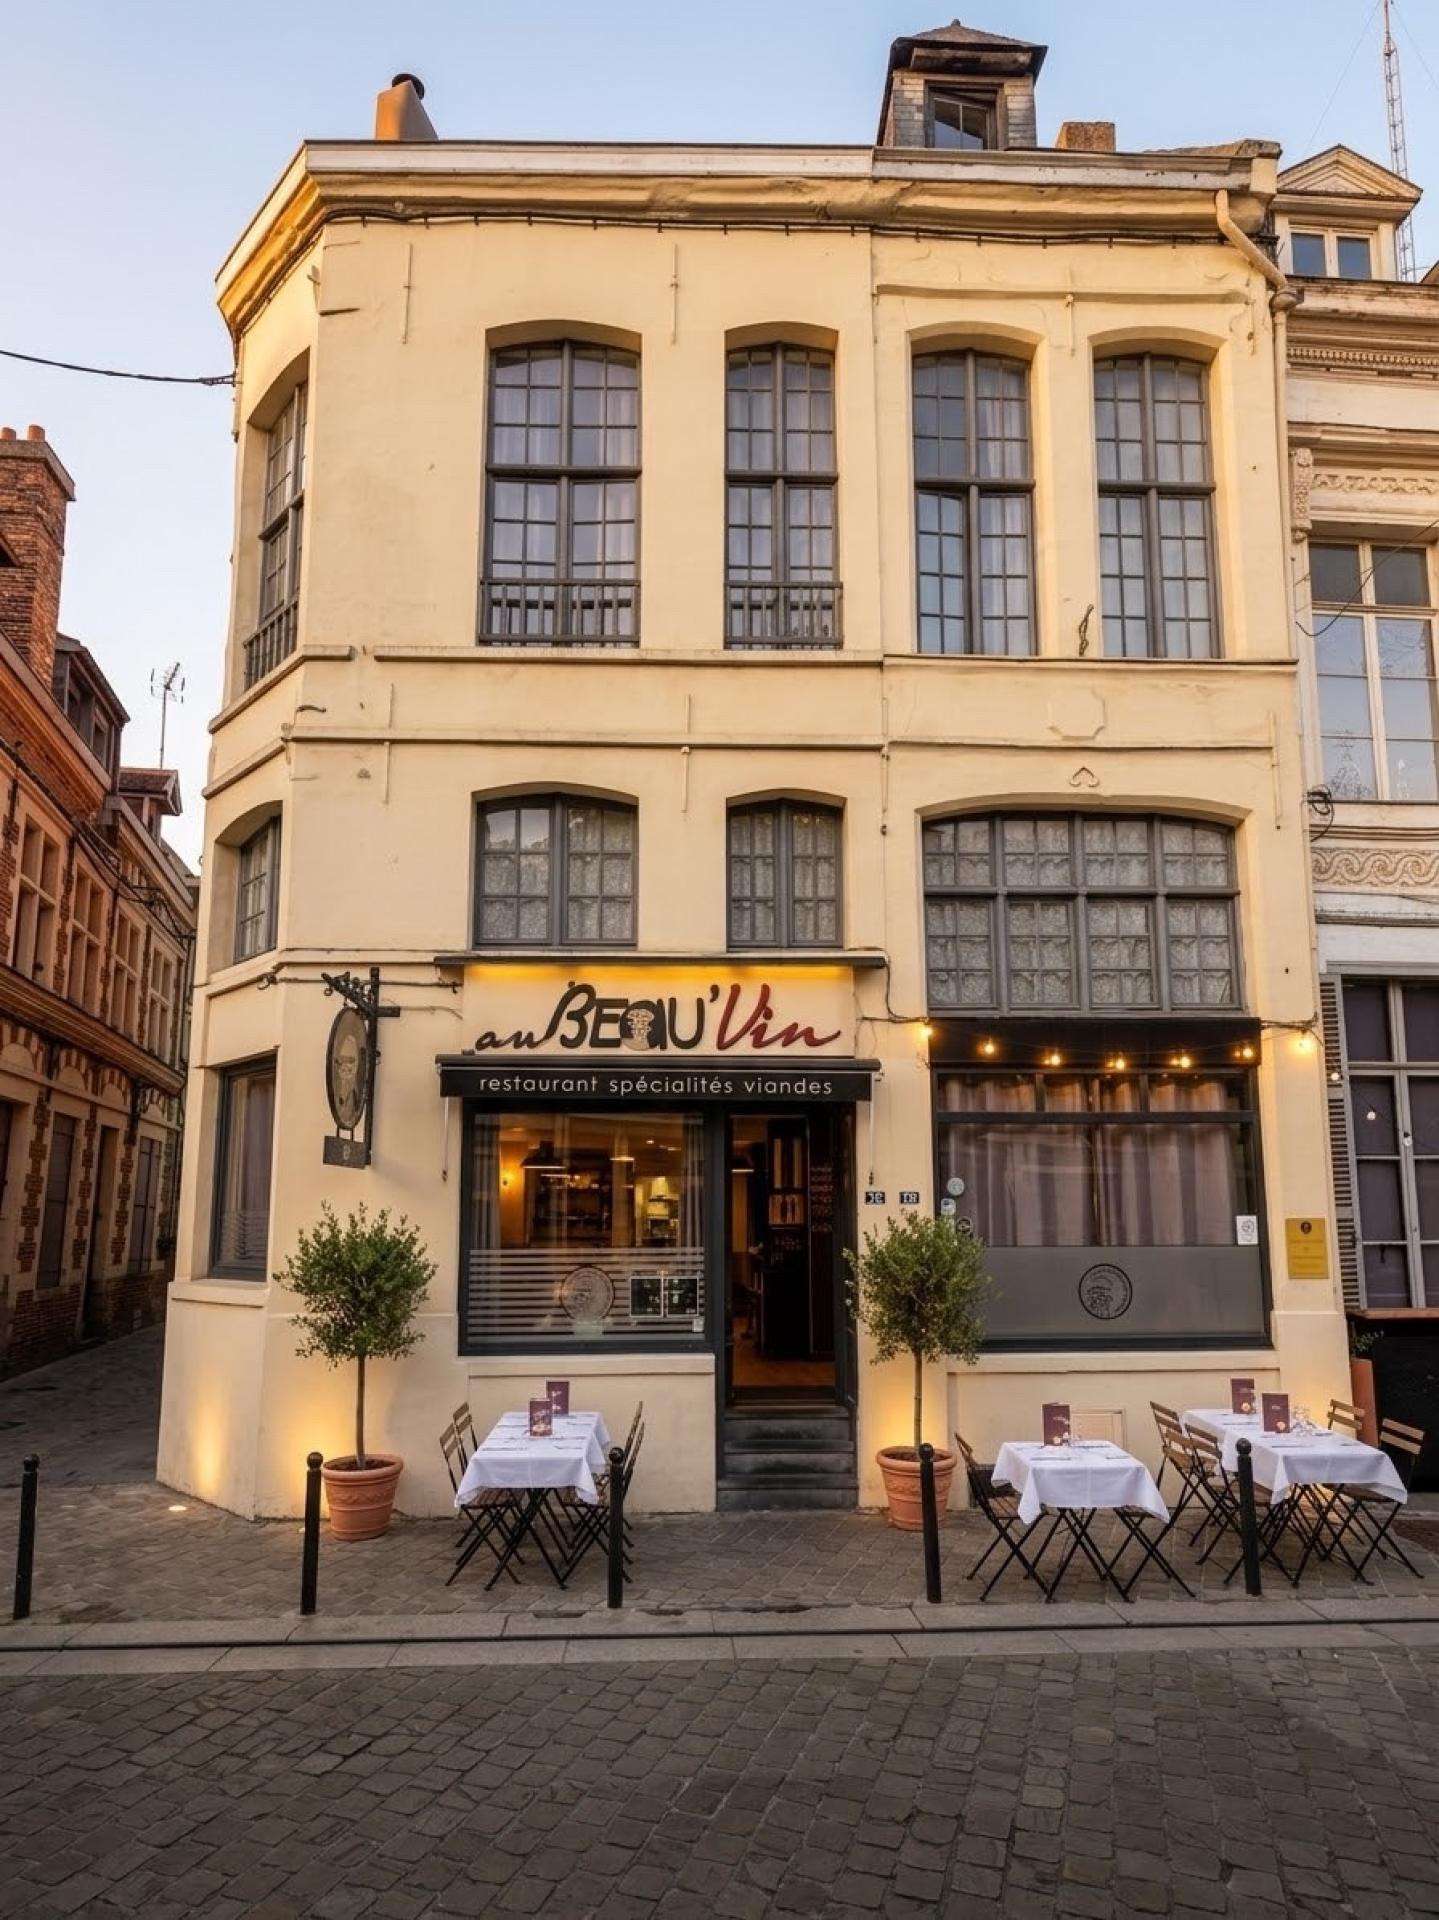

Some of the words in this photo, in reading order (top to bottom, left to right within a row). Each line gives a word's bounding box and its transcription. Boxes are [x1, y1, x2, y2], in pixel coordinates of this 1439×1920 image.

[475, 1030, 541, 1051] au
[480, 1076, 598, 1093] restaurant
[609, 1075, 732, 1097] spécialités
[744, 1077, 833, 1095] viandes
